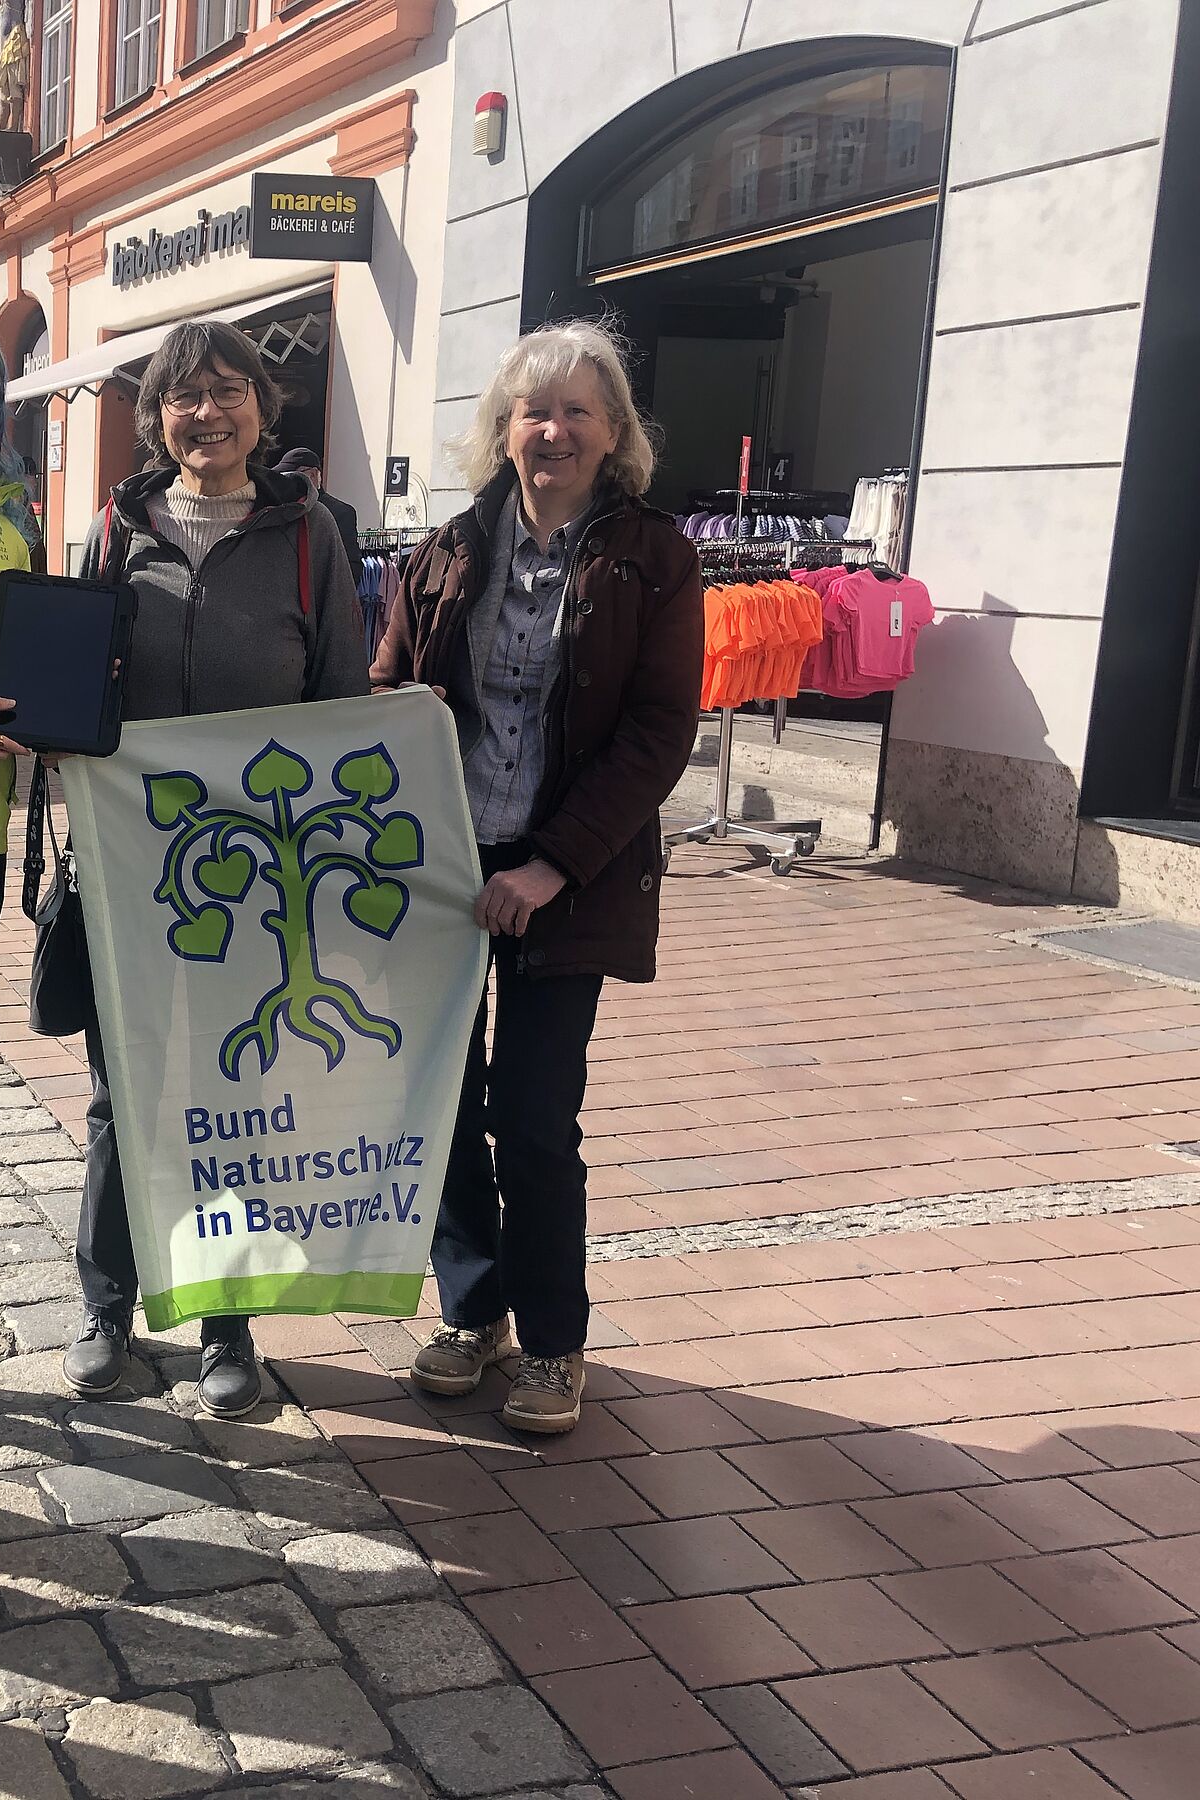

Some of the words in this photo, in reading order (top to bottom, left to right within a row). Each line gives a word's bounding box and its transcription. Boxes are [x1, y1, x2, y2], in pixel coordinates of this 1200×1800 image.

[271, 190, 357, 213] mareis
[112, 208, 206, 287] bäckerei
[210, 205, 250, 252] ma
[270, 215, 318, 232] BÄCKEREI
[320, 219, 328, 233] &
[331, 217, 355, 234] CAFÉ
[184, 1093, 296, 1144] Bund
[190, 1131, 424, 1192] Naturschutz
[194, 1204, 232, 1239] in
